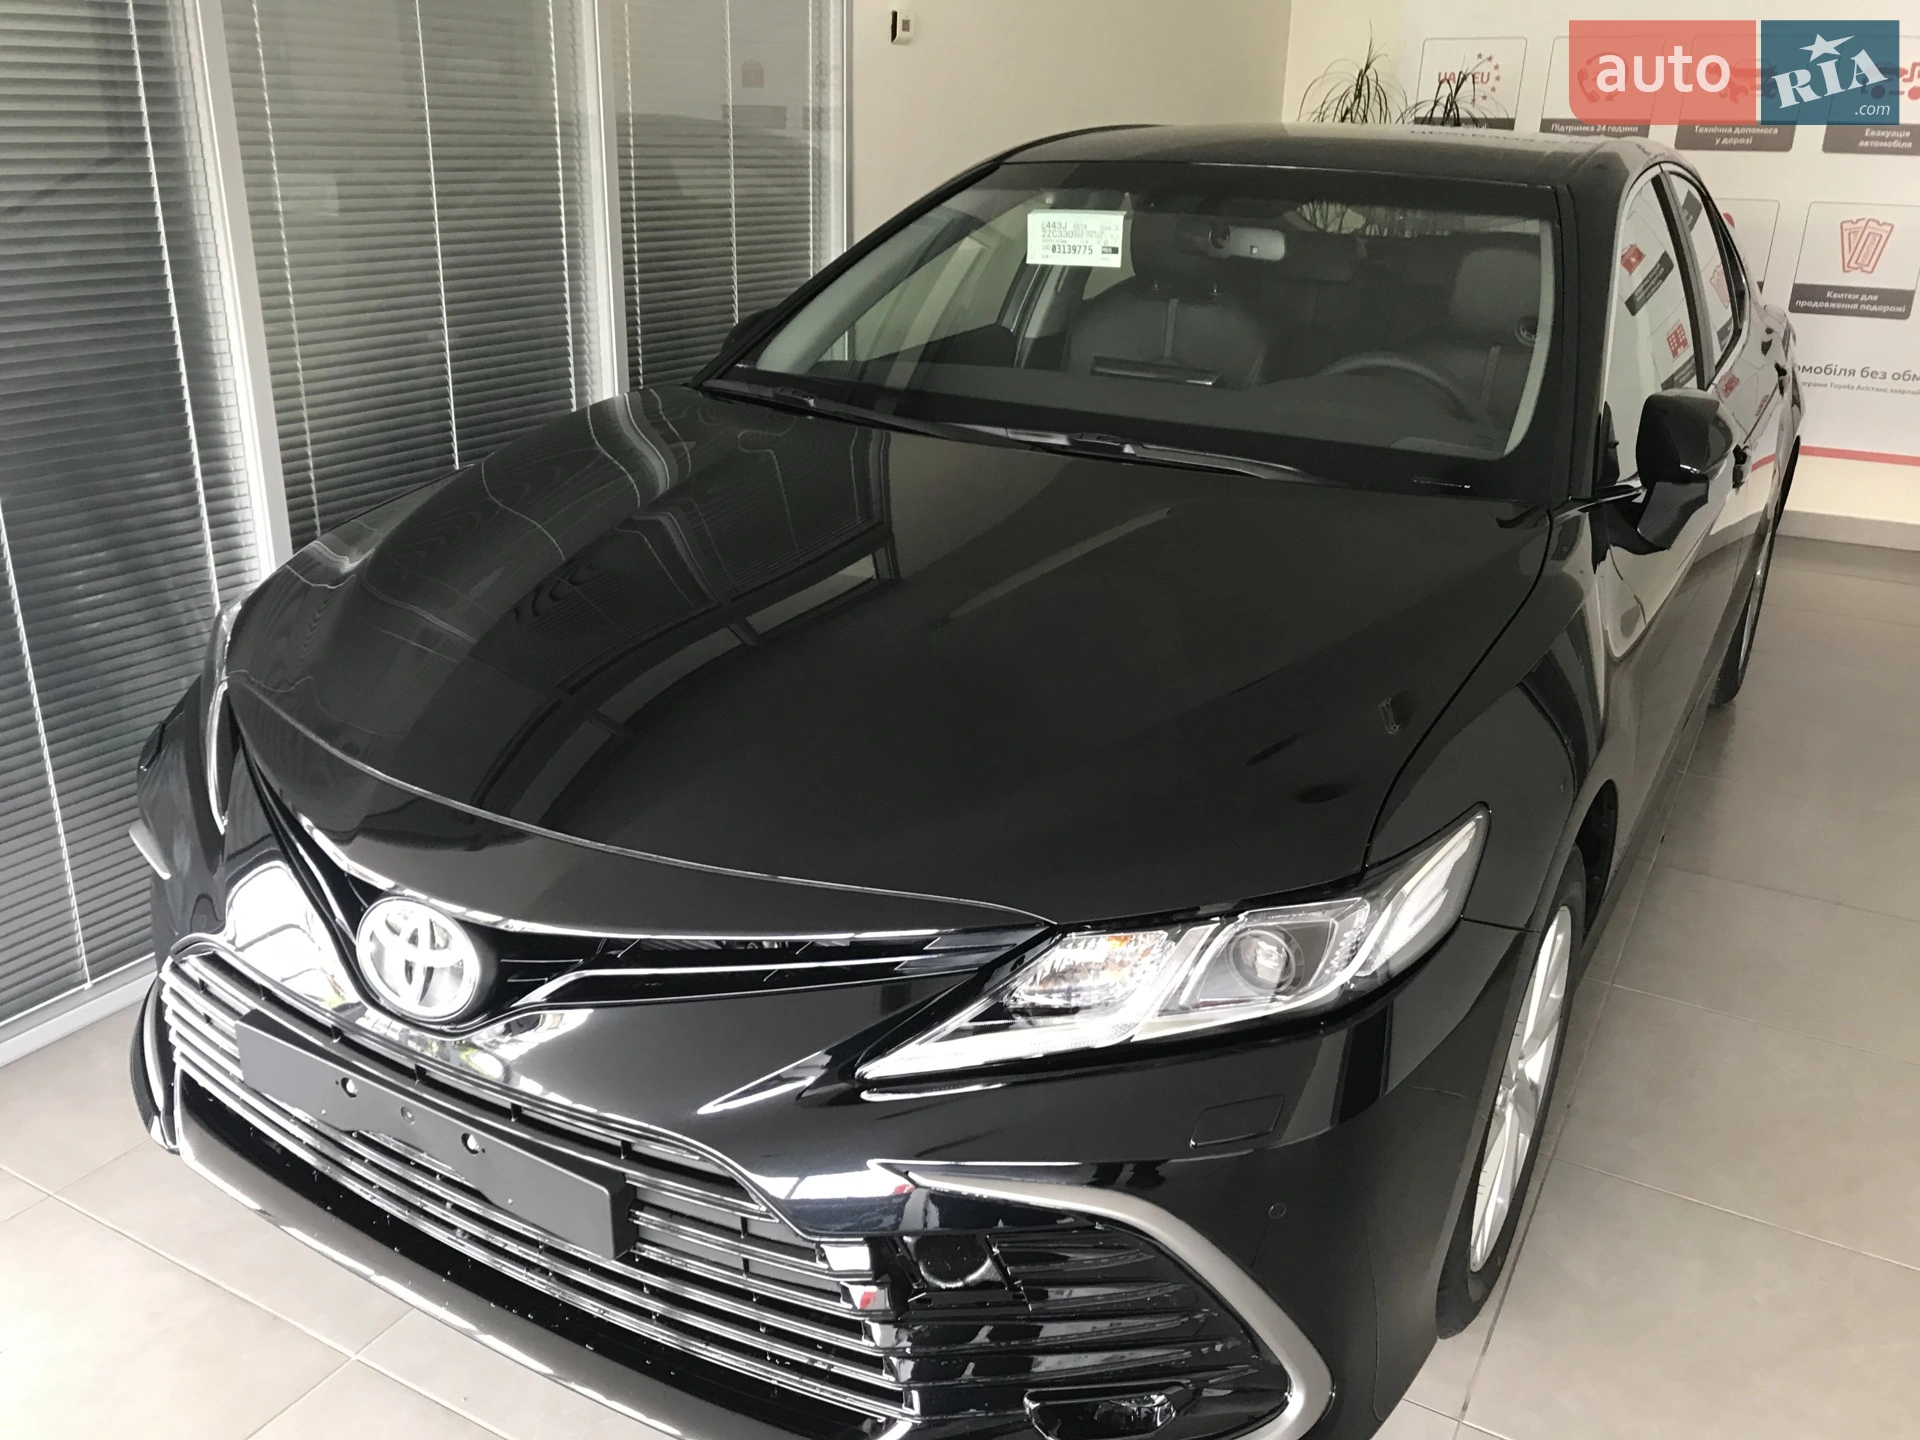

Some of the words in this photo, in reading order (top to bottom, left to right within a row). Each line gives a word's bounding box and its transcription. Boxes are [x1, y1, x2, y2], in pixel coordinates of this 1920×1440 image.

[1551, 123, 1595, 133] Підтримка
[1596, 124, 1606, 133] 24
[1607, 125, 1639, 134] години
[1694, 125, 1733, 135] Технічна
[1733, 126, 1779, 136] допомога
[1864, 127, 1911, 138] Евакуація
[1721, 136, 1753, 146] дорозі
[1858, 139, 1913, 149] автомобіля
[1051, 244, 1093, 254] 03139775
[1826, 290, 1859, 300] Квитки
[1859, 293, 1879, 302] для
[1795, 299, 1858, 309] продовження
[1859, 303, 1907, 313] подорожі
[1860, 366, 1888, 380] без
[1829, 381, 1855, 391] Toyota
